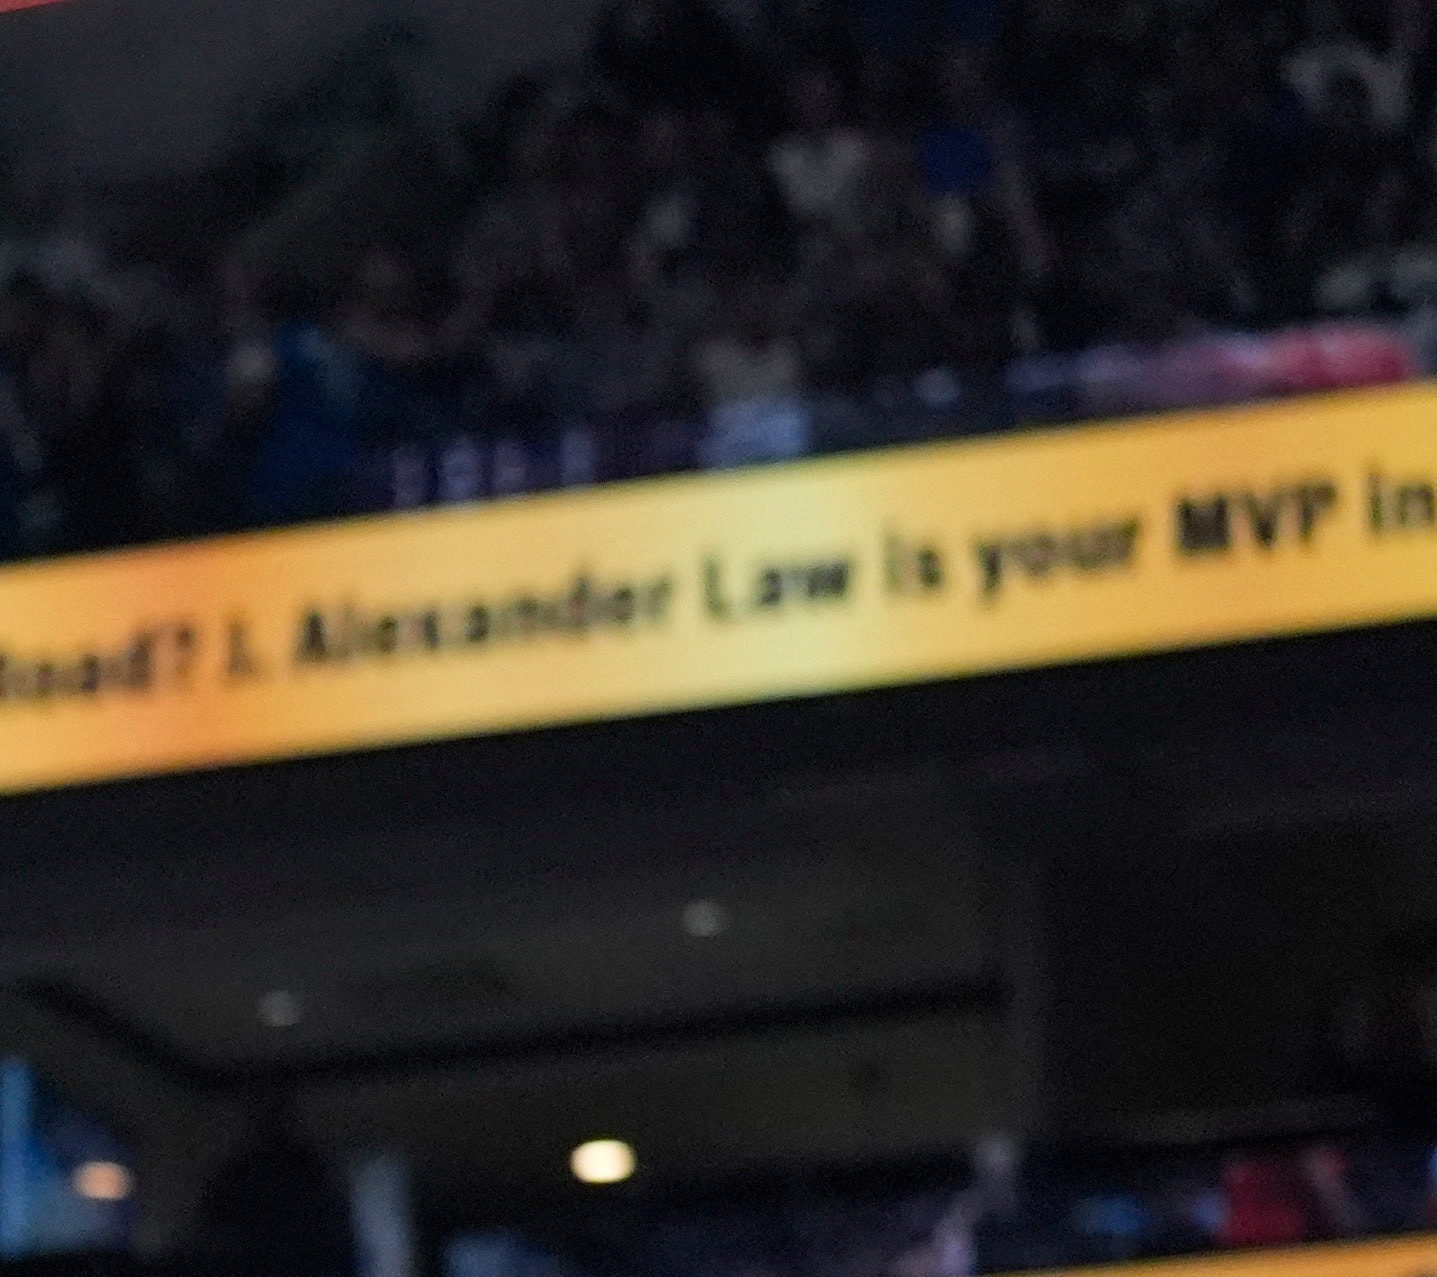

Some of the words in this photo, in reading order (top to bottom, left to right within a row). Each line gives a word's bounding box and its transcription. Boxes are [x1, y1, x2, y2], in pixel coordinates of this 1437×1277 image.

[296, 560, 673, 664] Alexander
[702, 550, 853, 620] Law
[884, 526, 942, 596] is
[974, 518, 1142, 608] your
[1175, 478, 1338, 558] MVP
